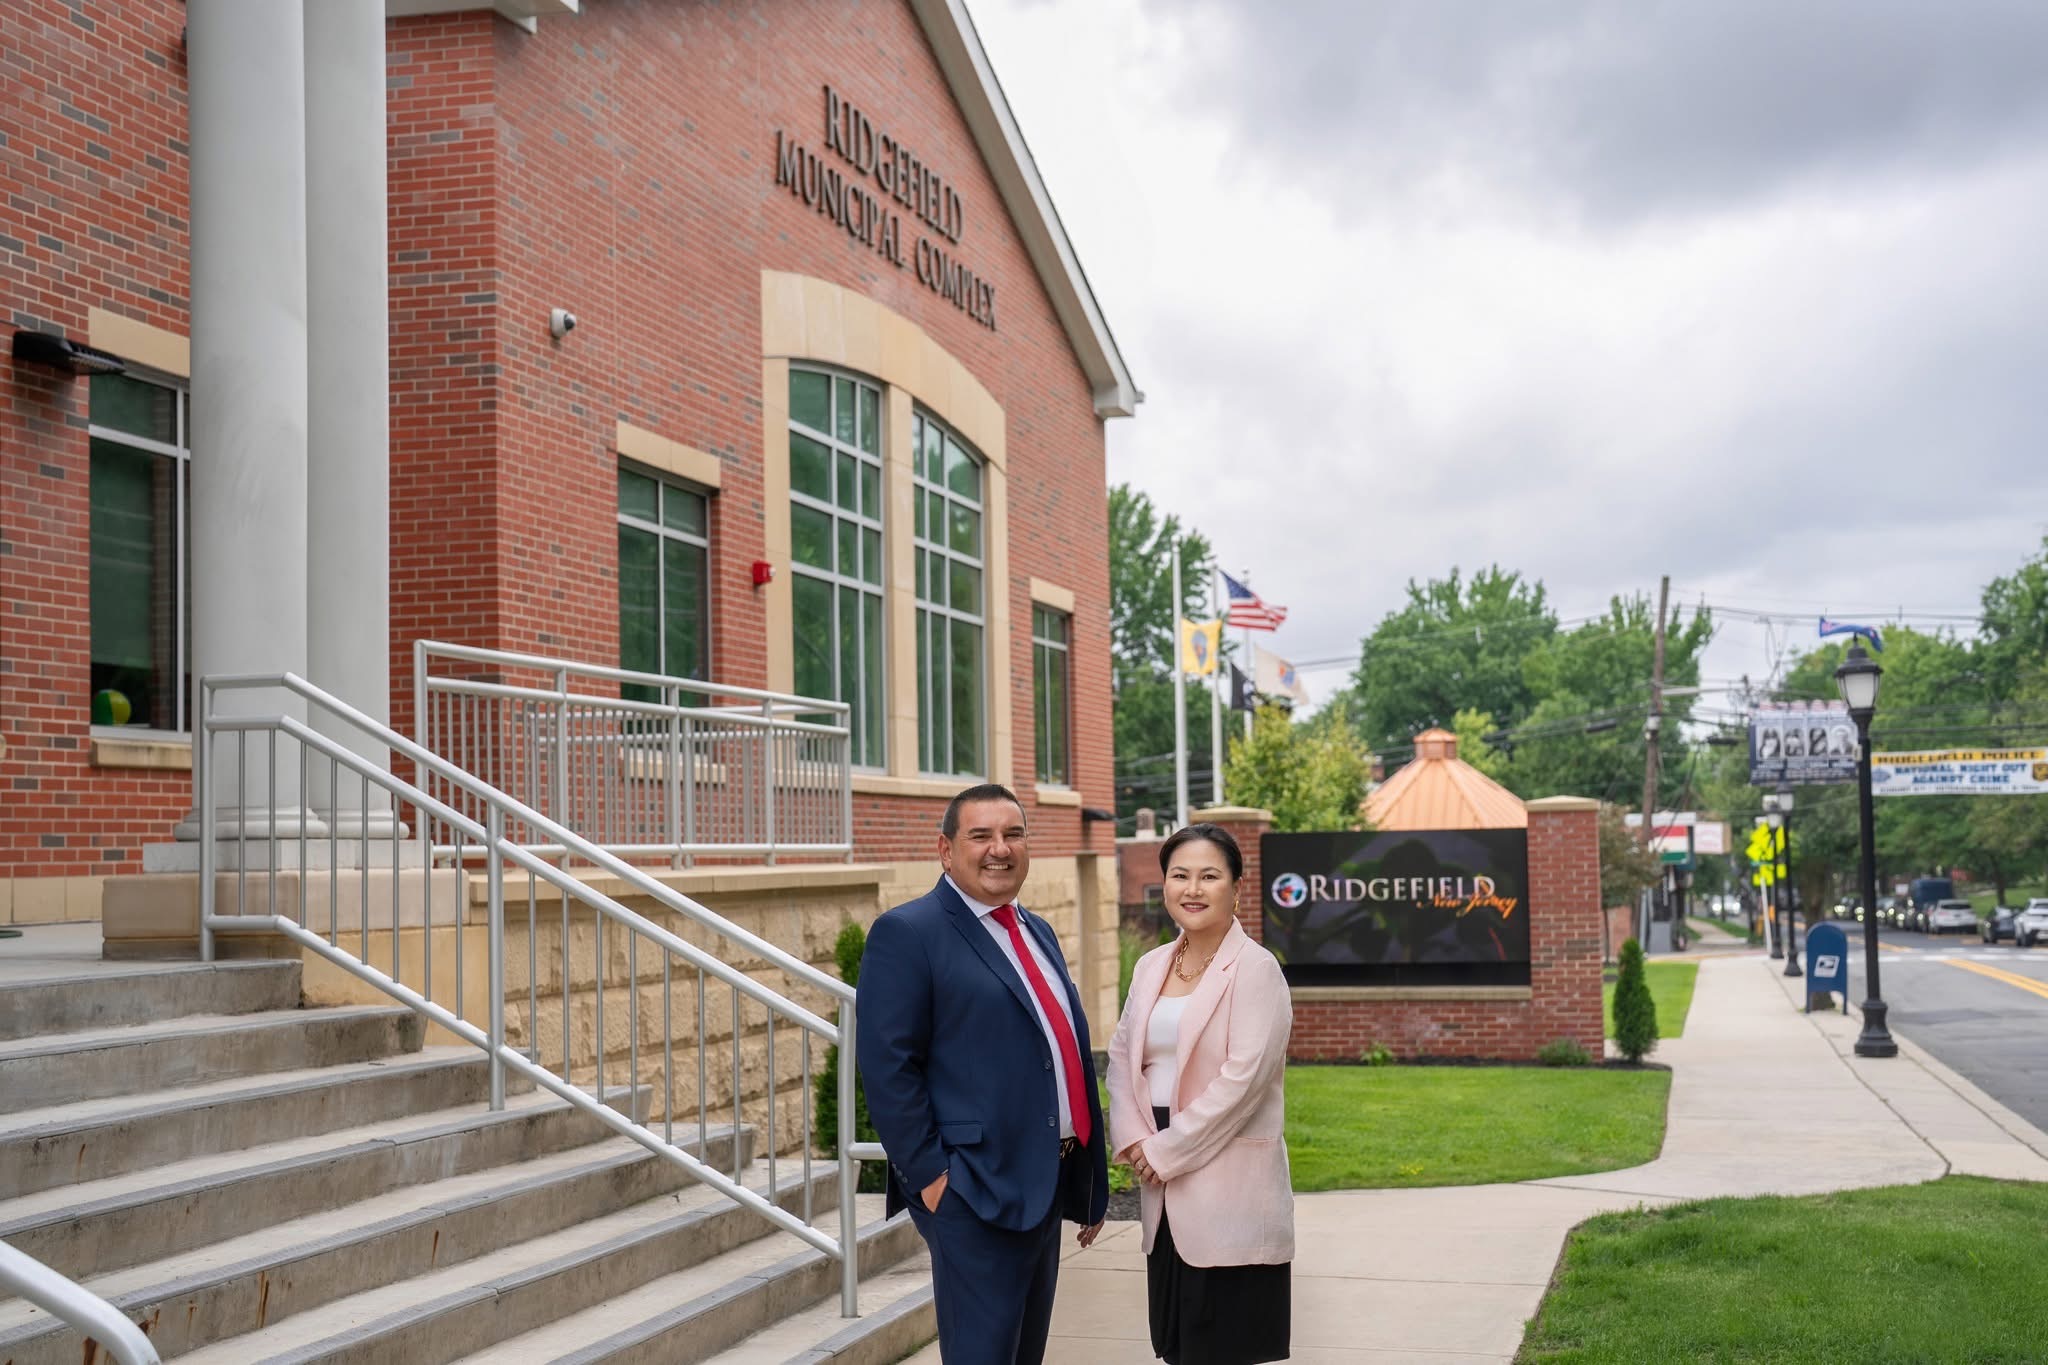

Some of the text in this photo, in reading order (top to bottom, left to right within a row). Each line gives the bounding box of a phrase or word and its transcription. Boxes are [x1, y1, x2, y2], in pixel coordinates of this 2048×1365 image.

[823, 84, 965, 246] RIDGEFIELD
[775, 129, 997, 332] MUNICIPAL COMPLEX
[1981, 751, 2040, 760] POLICE
[1895, 762, 2027, 774] NATIONAL NIGHT OUT
[1912, 775, 2009, 784] AGAINST CRIME
[1309, 873, 1496, 902] RIDGEFIELD
